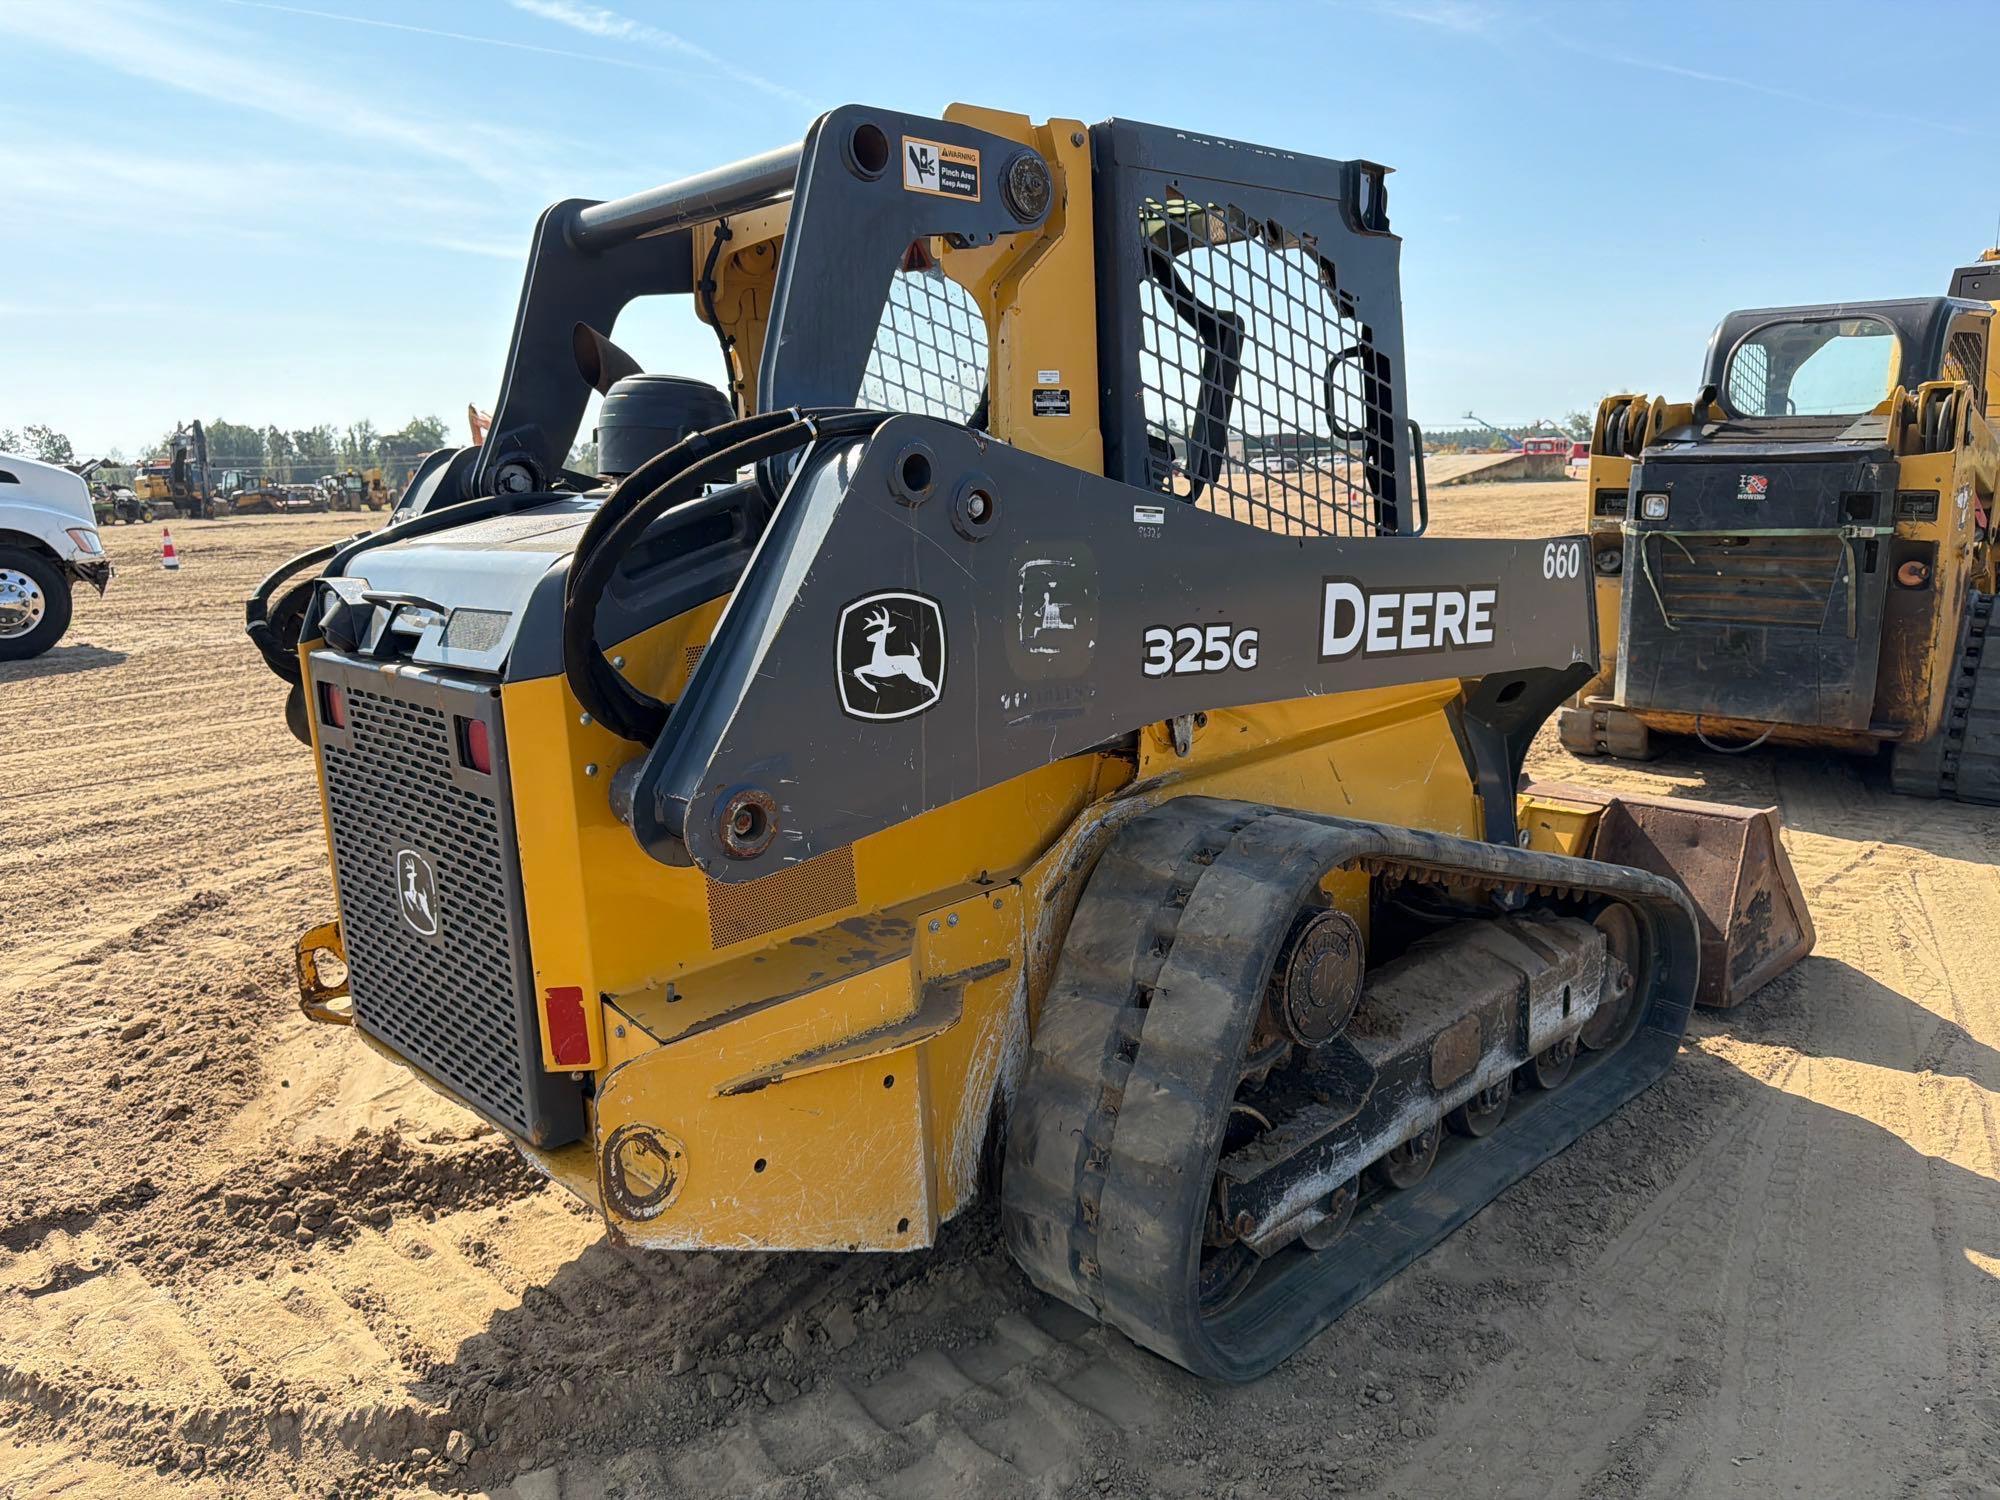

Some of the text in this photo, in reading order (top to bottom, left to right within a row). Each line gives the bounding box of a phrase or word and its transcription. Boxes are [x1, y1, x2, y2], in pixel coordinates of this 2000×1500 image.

[948, 150, 976, 161] WARNING
[941, 167, 975, 180] Pinch Area
[941, 178, 970, 190] Keep Away
[1543, 543, 1580, 580] 660
[1322, 582, 1497, 656] DEERE
[1144, 626, 1258, 676] 325G
